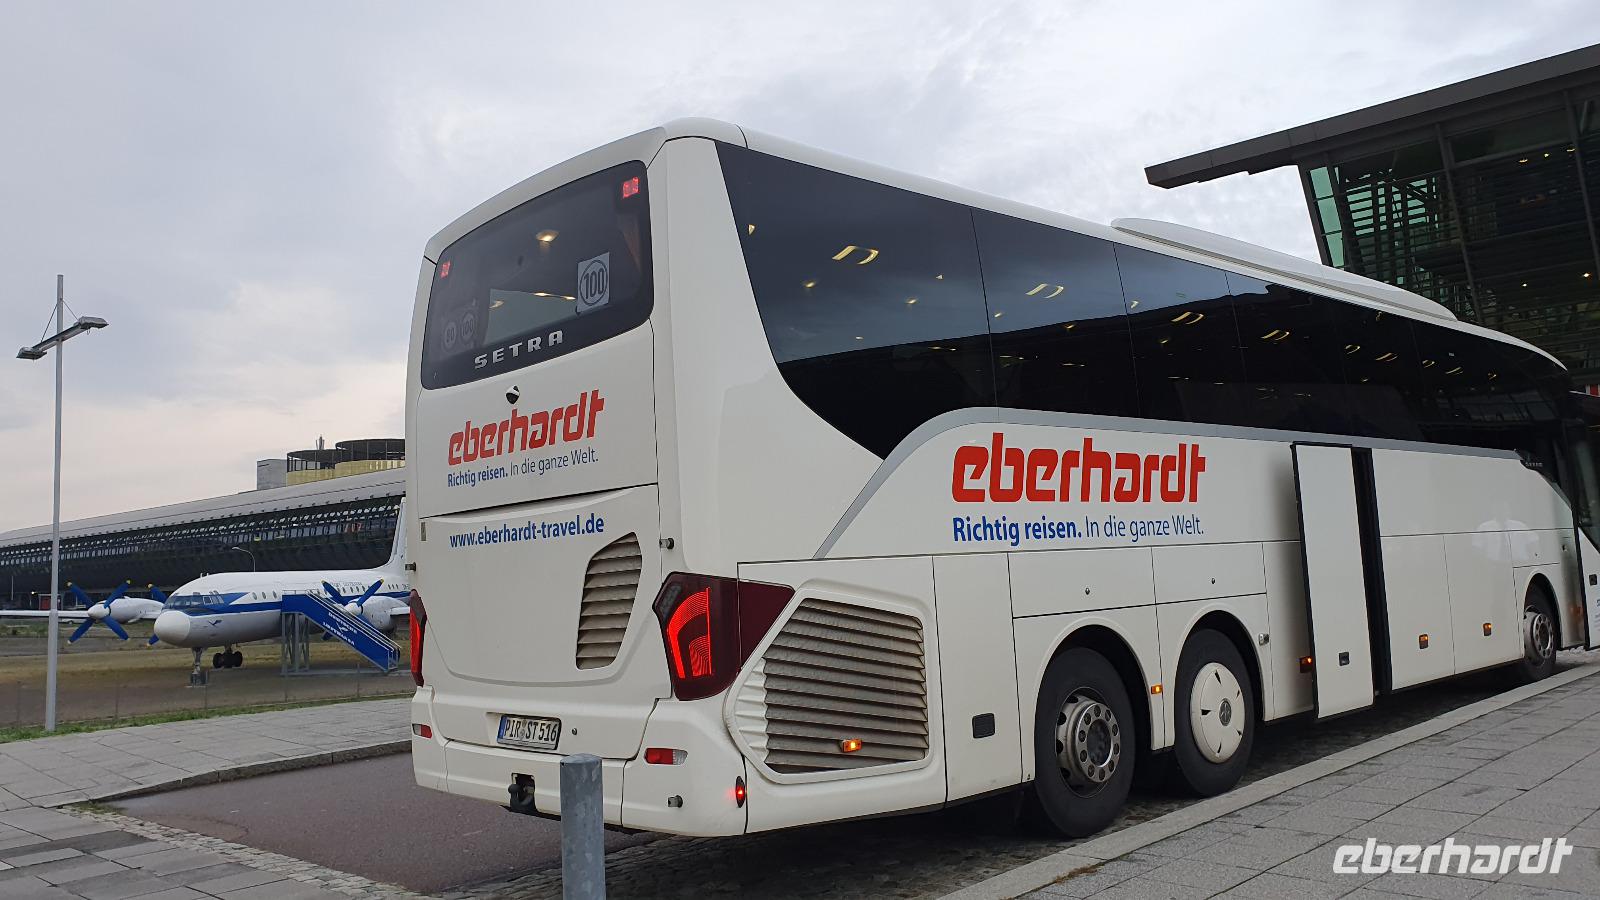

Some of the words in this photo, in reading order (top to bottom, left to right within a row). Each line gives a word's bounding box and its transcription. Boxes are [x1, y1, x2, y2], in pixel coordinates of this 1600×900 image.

[583, 267, 605, 300] 100
[474, 330, 563, 369] SETRA
[448, 389, 604, 466] eberhardt
[448, 466, 476, 488] Richtig
[477, 465, 508, 483] reisen.
[510, 461, 519, 477] In
[521, 457, 536, 475] die
[538, 455, 569, 476] ganze
[571, 446, 599, 465] Welt.
[952, 432, 1206, 503] eberhardt
[450, 512, 604, 548] www.eberhardt-travel.de
[952, 515, 1020, 547] Richtig
[1024, 515, 1083, 540] reisen.
[1086, 515, 1101, 538] In
[1104, 514, 1126, 538] die
[1130, 518, 1170, 543] ganze
[1172, 513, 1204, 536] Welt.
[504, 719, 521, 738] PIR
[526, 721, 538, 740] ST
[538, 723, 558, 742] 516
